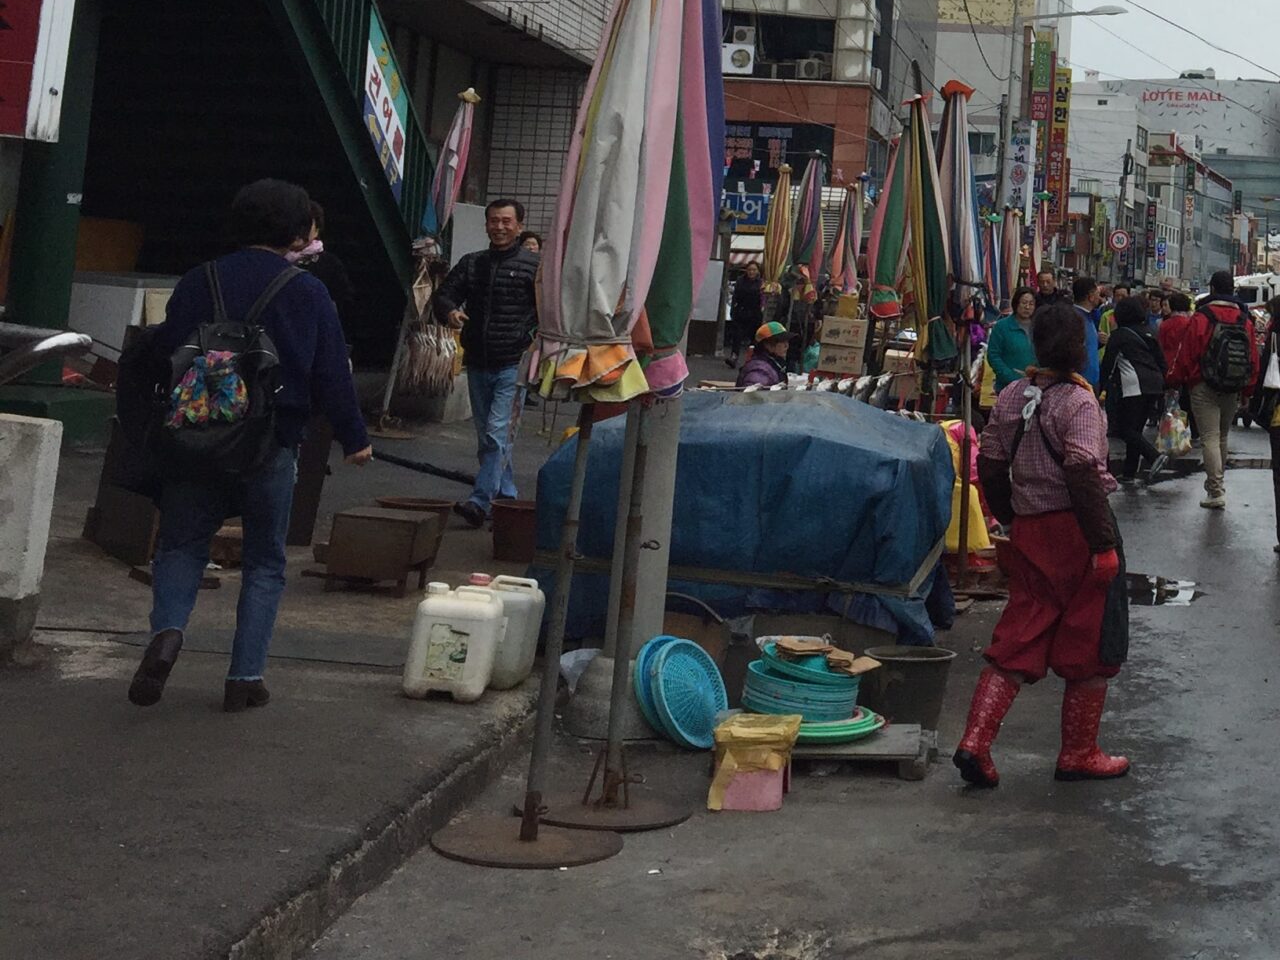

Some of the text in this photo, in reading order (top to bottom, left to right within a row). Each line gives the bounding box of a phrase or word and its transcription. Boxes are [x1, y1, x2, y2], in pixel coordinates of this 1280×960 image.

[1143, 91, 1225, 102] LOTTE MALL
[1114, 236, 1125, 245] 30
